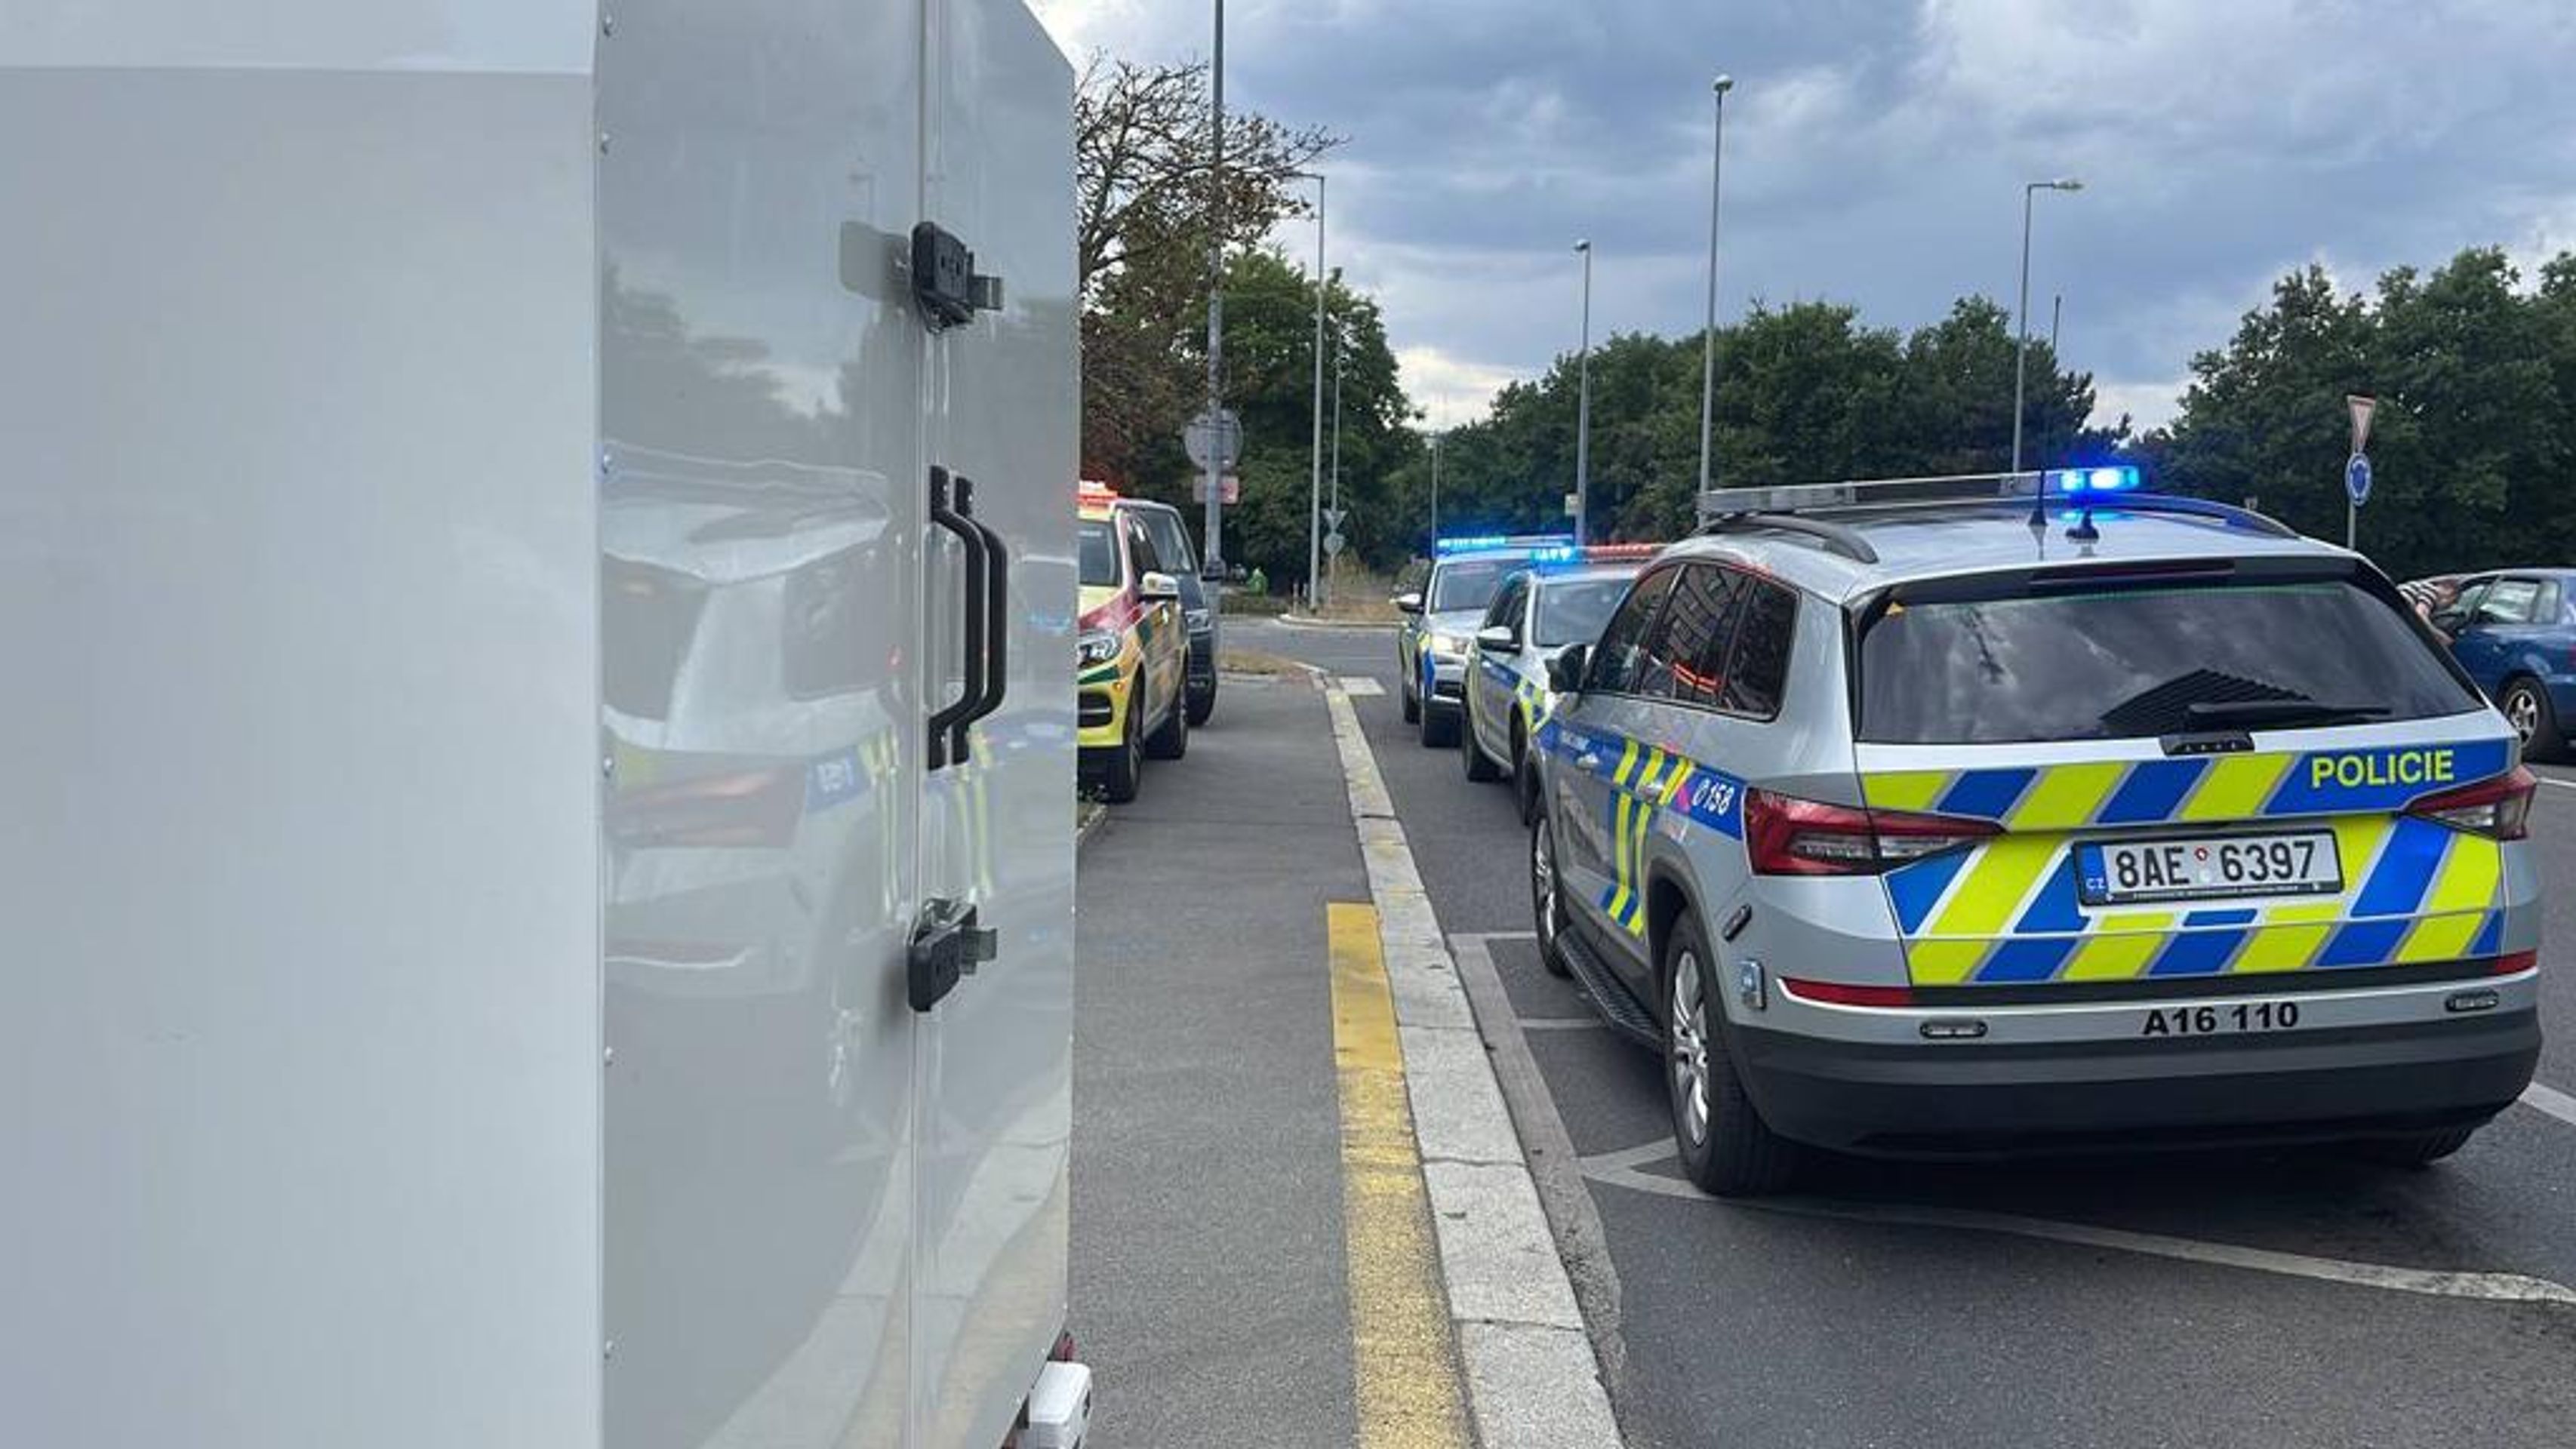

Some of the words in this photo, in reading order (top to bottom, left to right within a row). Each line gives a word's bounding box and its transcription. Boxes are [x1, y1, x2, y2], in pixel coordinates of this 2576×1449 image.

[2311, 750, 2454, 787] POLICIE
[2116, 846, 2189, 888] 8AE
[2220, 840, 2316, 881] 6397
[2085, 878, 2105, 890] CZ
[2143, 1006, 2217, 1035] A16
[2232, 1001, 2299, 1031] 110
